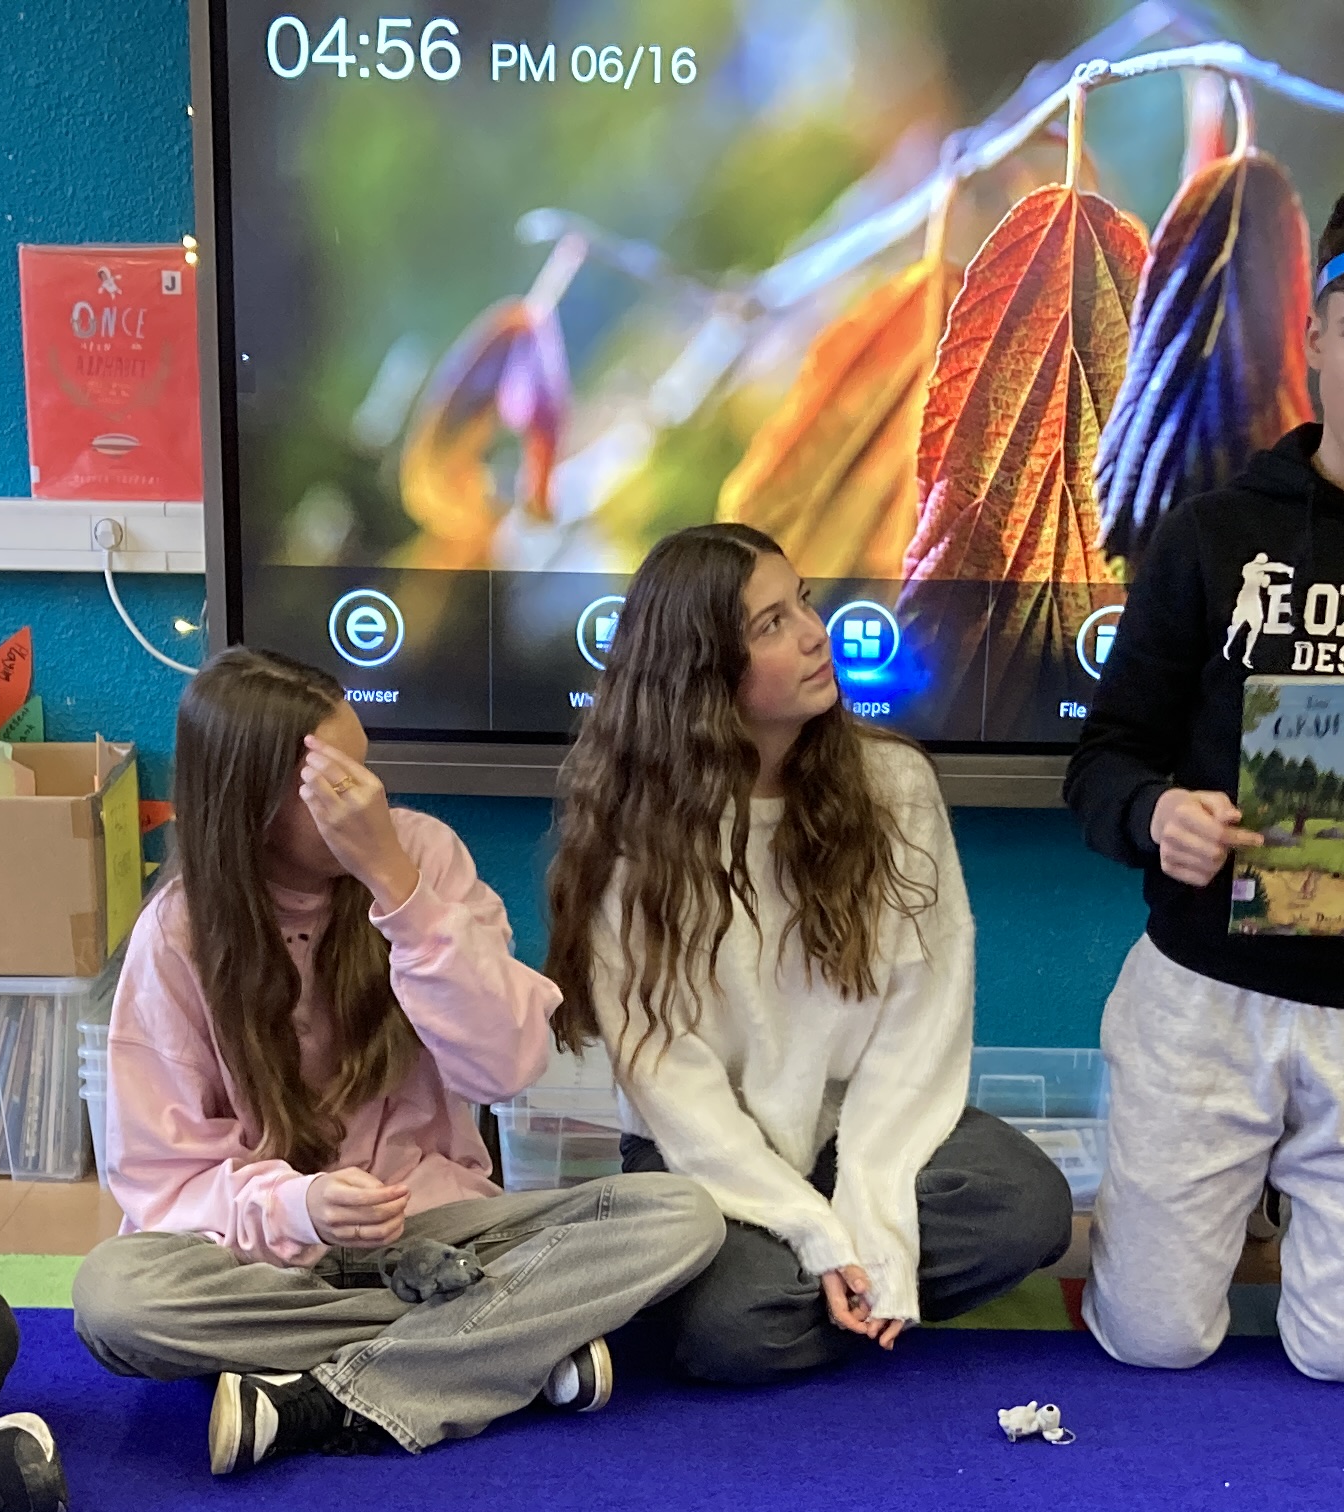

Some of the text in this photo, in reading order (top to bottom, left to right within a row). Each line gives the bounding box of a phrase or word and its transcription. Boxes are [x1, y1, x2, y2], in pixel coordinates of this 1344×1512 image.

[267, 16, 697, 90] 04:56 PM 06/16
[164, 276, 176, 291] J
[70, 300, 148, 339] ONCE
[344, 689, 399, 703] rowser
[852, 701, 891, 718] apps
[1059, 701, 1087, 718] File
